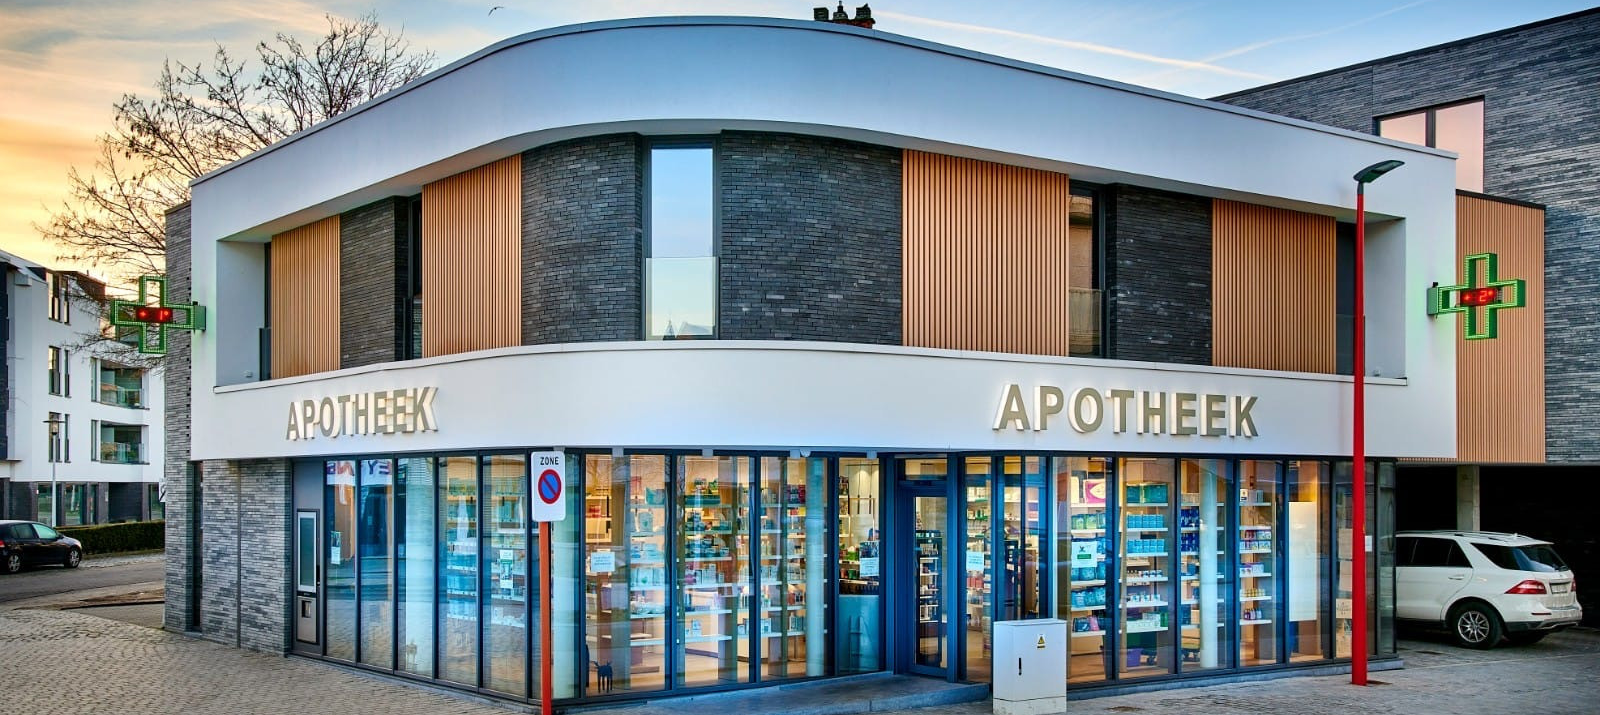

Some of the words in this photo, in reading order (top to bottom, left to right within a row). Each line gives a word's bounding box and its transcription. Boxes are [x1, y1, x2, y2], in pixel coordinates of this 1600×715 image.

[286, 387, 438, 441] APOTHEEK
[992, 384, 1259, 437] APOTHEEK
[540, 456, 560, 466] ZONE
